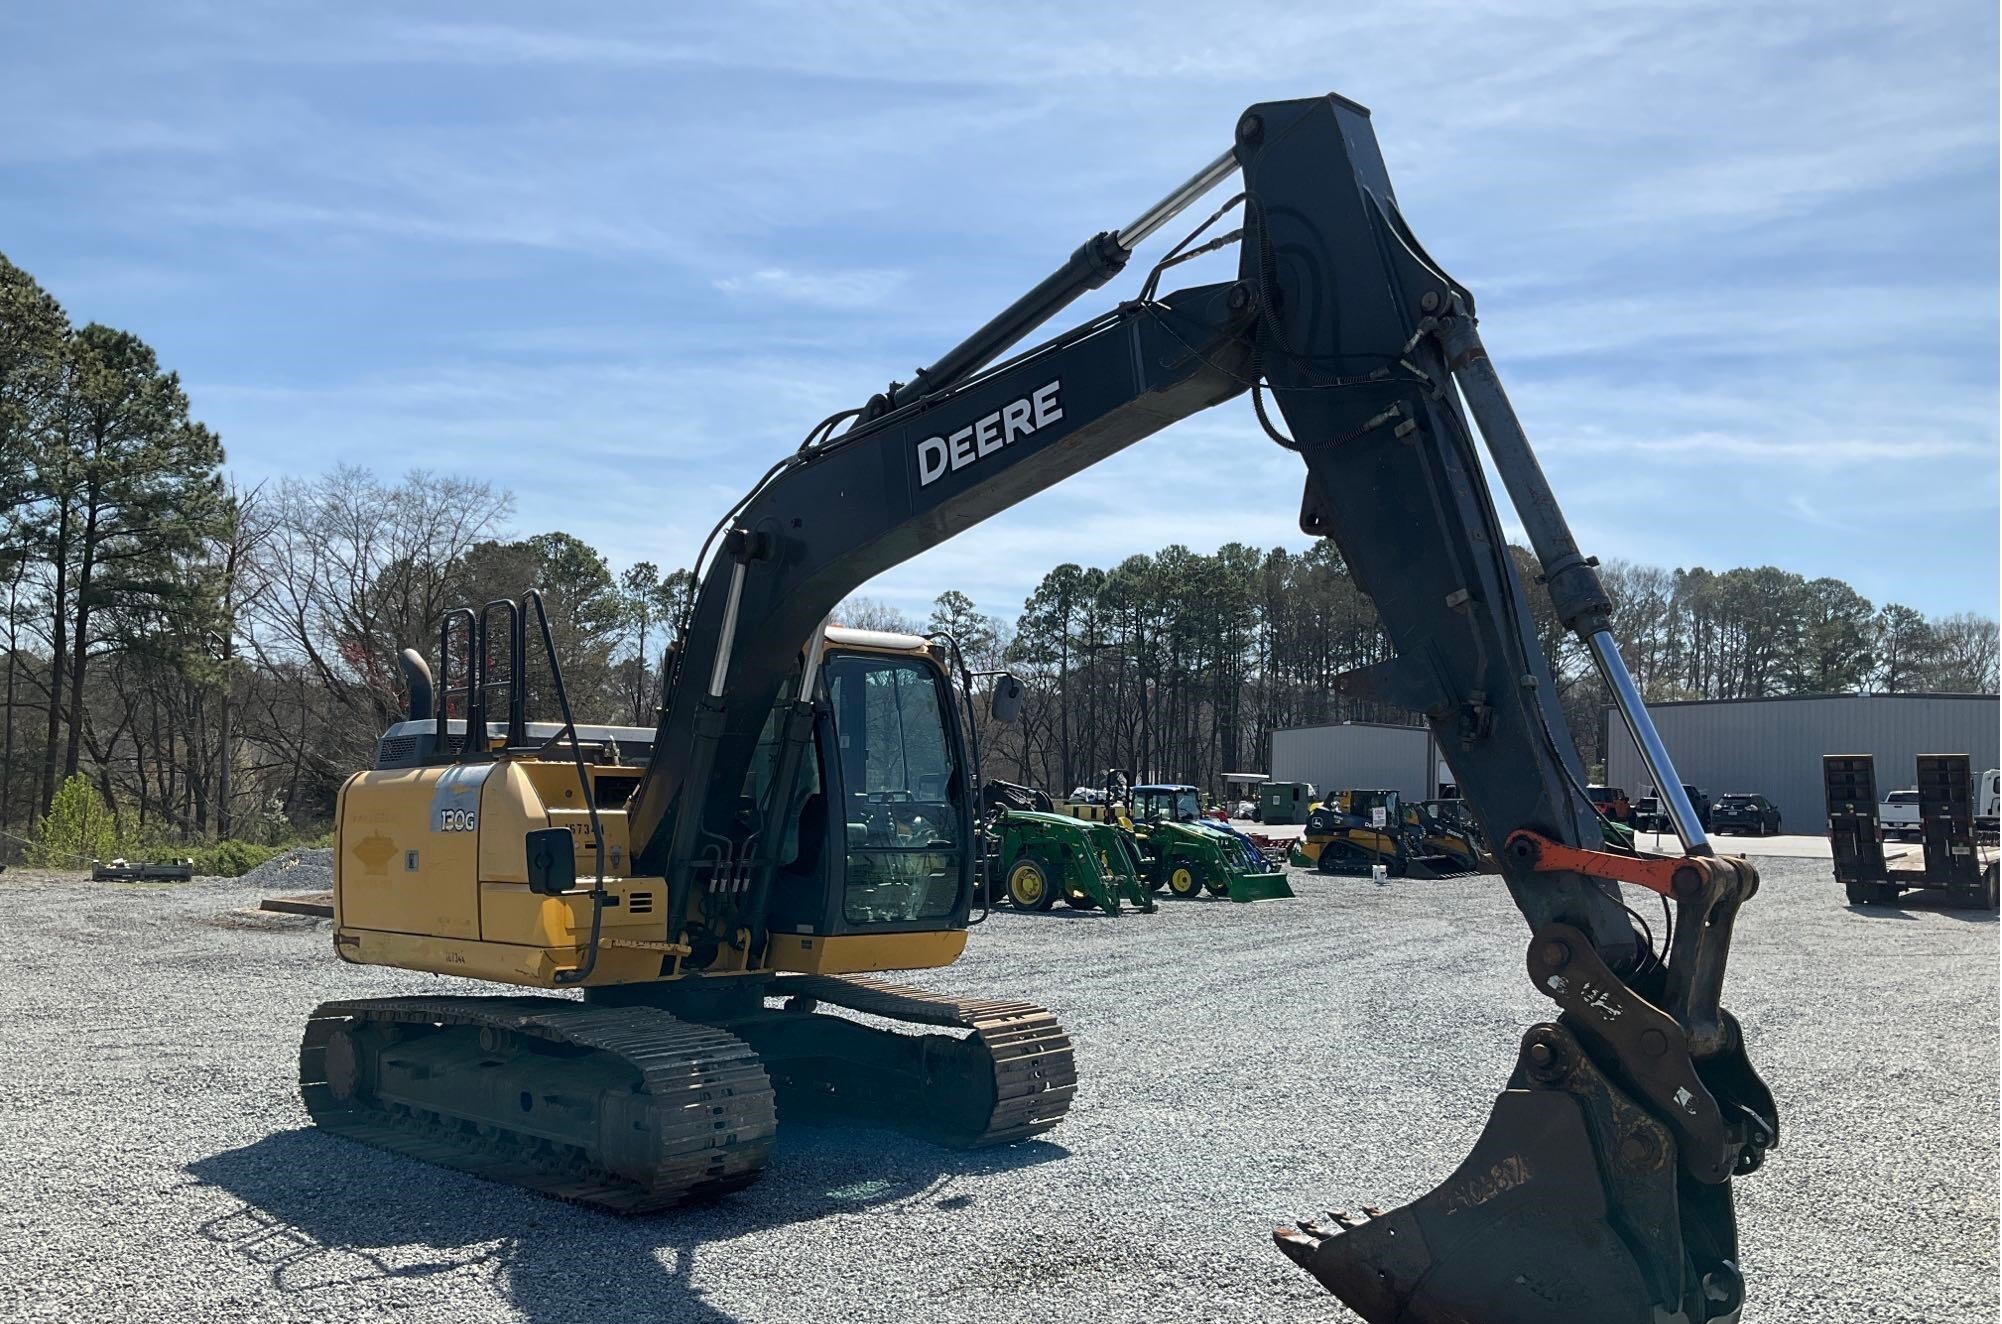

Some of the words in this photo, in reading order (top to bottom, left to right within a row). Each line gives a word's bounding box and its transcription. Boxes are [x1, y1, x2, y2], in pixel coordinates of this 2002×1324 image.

[917, 380, 1063, 486] DEERE
[441, 809, 475, 831] 130G
[565, 823, 604, 834] 673
